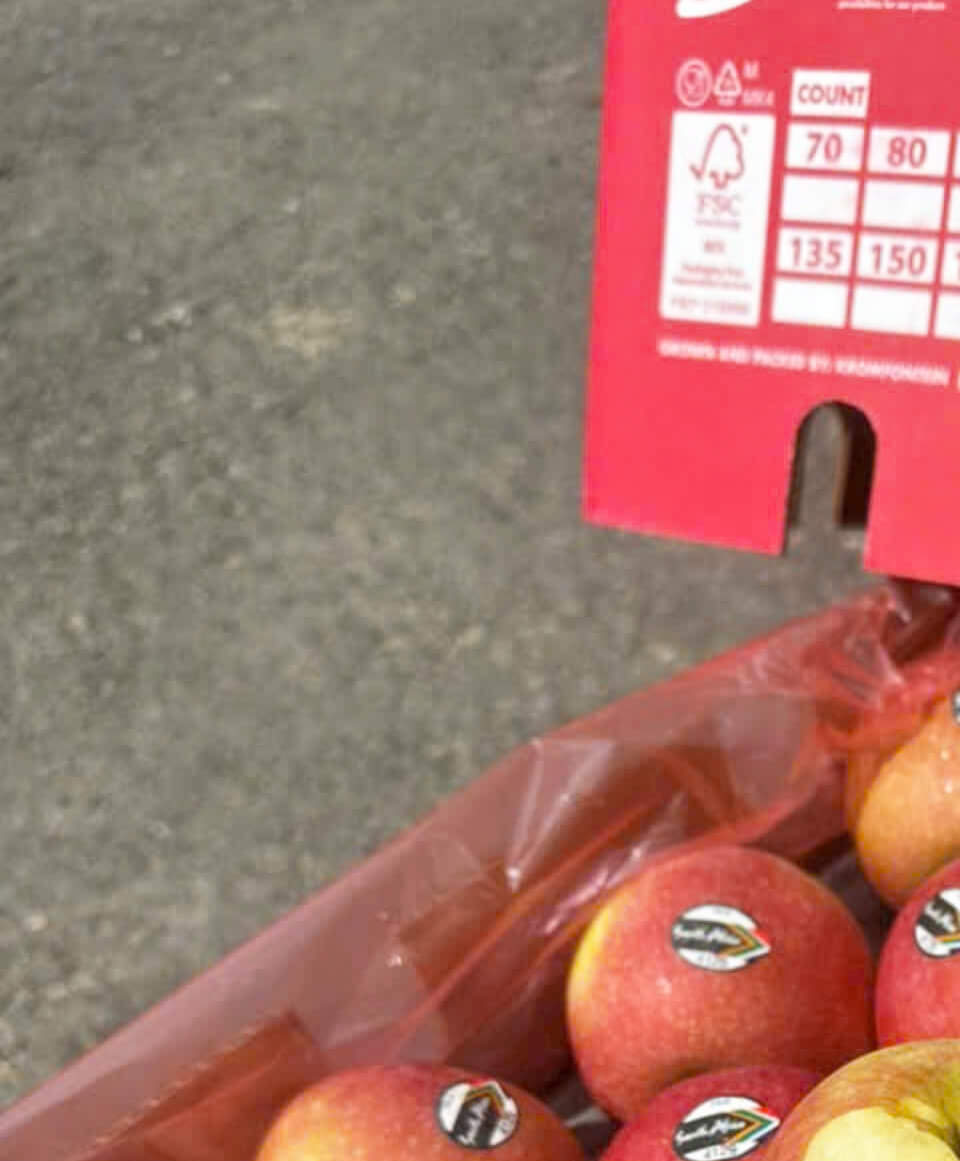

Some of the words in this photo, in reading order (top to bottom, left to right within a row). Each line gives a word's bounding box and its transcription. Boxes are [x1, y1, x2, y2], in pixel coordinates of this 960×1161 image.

[797, 83, 866, 107] COUNT
[805, 132, 843, 162] 70
[887, 136, 927, 168] 80
[790, 237, 843, 269] 135
[870, 243, 927, 276] 150
